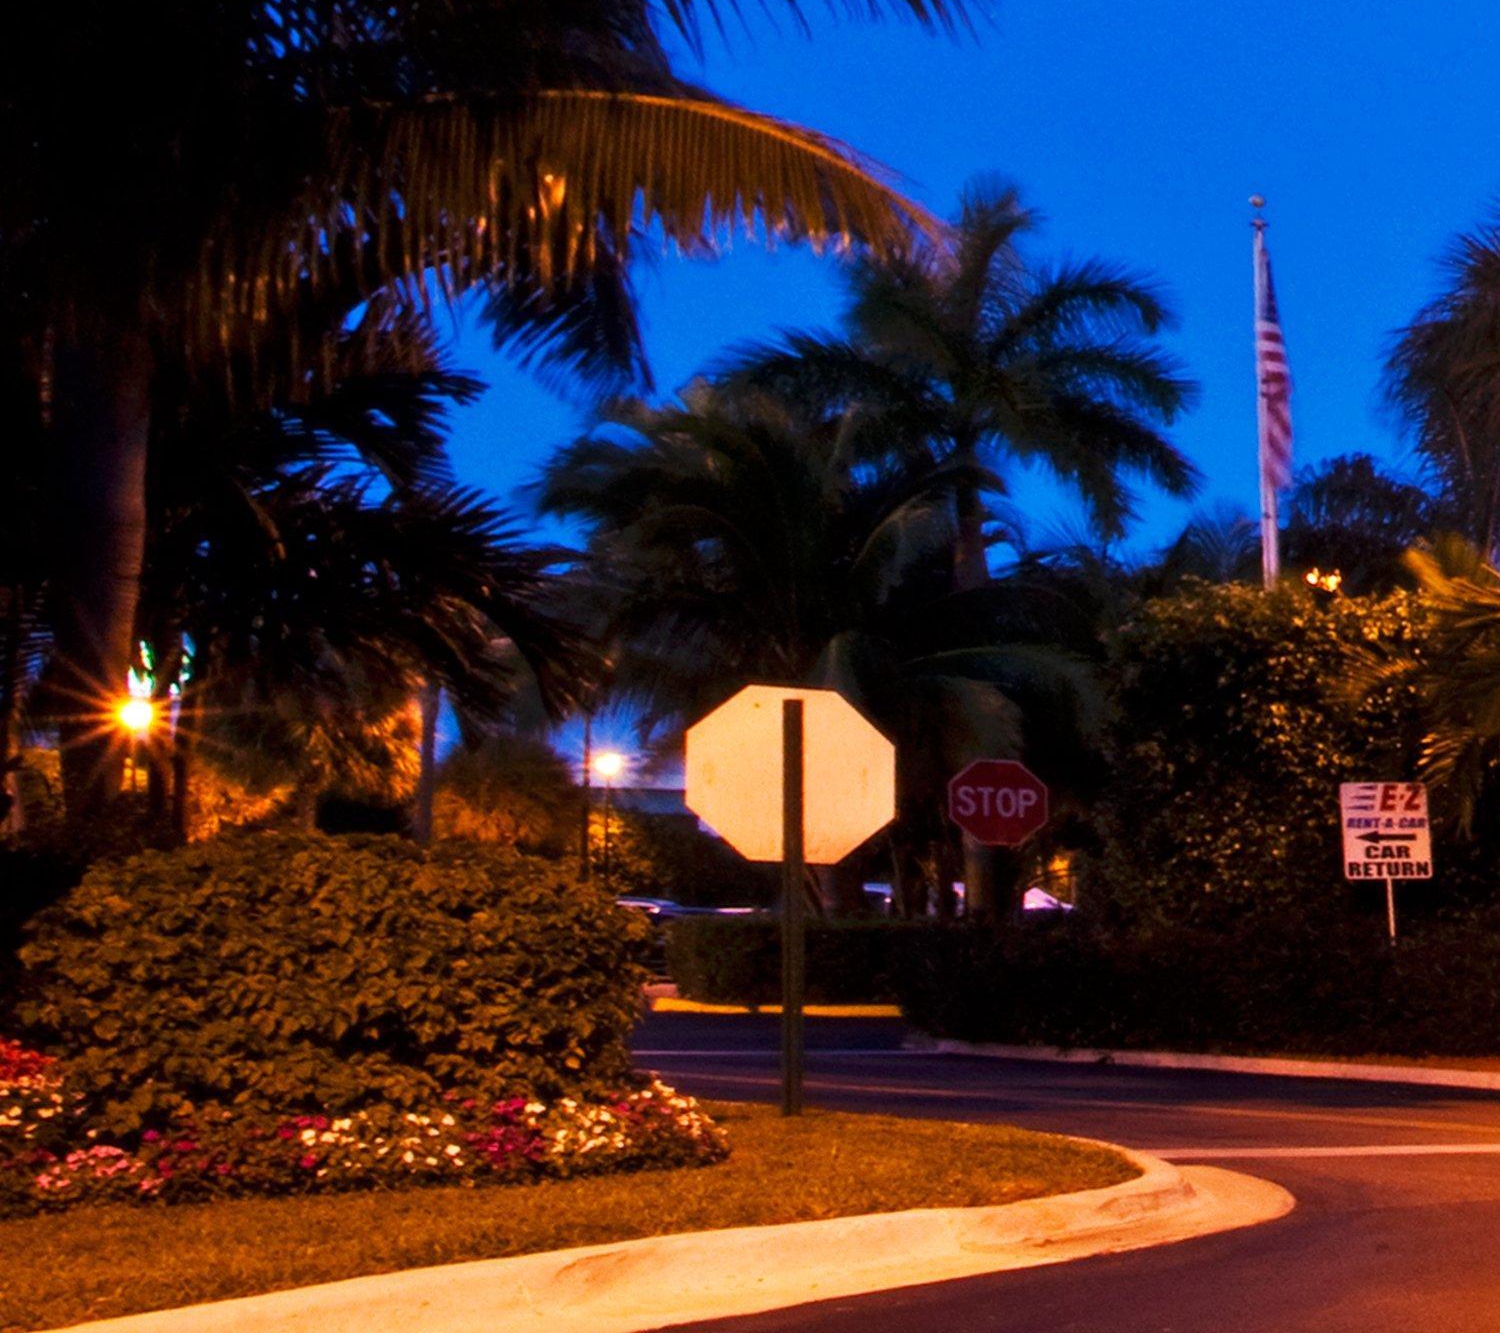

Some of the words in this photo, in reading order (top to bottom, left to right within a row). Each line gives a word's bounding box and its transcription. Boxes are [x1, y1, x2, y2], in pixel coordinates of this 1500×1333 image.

[957, 785, 1038, 818] STOP
[1380, 784, 1422, 811] E-Z
[1365, 845, 1411, 859] CAR
[1348, 861, 1429, 876] RETURN
